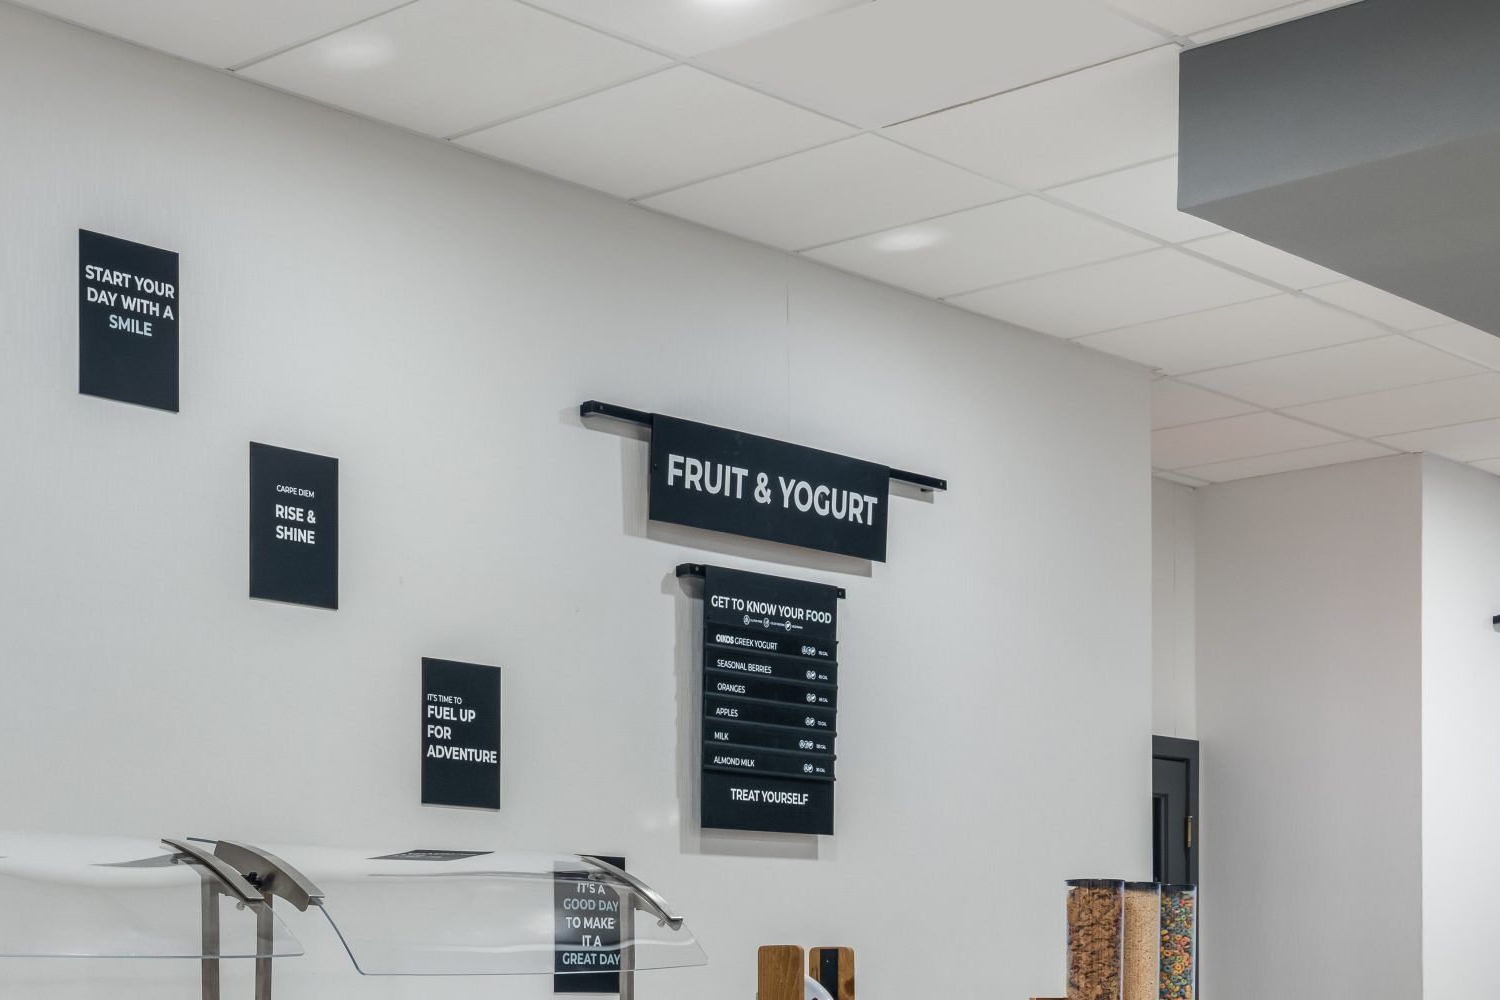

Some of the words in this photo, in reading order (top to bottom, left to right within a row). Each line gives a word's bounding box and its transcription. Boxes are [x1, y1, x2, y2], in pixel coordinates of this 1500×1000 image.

[85, 264, 131, 288] START
[134, 276, 175, 299] YOUR
[87, 287, 118, 306] DAY
[121, 295, 159, 316] WITH
[163, 305, 174, 320] A
[109, 315, 153, 337] SMILE
[277, 485, 297, 495] CARPE
[299, 488, 314, 498] DIEM
[668, 453, 748, 499] FRUIT
[754, 472, 772, 505] &
[779, 476, 878, 526] YOGURT
[276, 504, 304, 522] RISE
[307, 510, 316, 524] &
[276, 525, 316, 544] SHINE
[711, 595, 730, 608] GET
[731, 598, 744, 610] TO
[747, 600, 776, 616] KNOW
[778, 605, 804, 620] YOUR
[806, 610, 832, 624] FOOD
[716, 634, 734, 644] OIKOS
[734, 637, 753, 647] GREEK
[754, 640, 778, 650] YOGURT
[717, 659, 746, 670] SEASONAL
[748, 663, 772, 674] BERRIES
[717, 682, 746, 693] ORANGES
[427, 694, 437, 702] IT'S
[438, 694, 452, 703] TIME
[453, 696, 462, 704] TO
[428, 705, 457, 720] FUEL
[460, 708, 476, 722] UP
[716, 708, 738, 717] APPLES
[428, 725, 451, 740] FOR
[714, 732, 729, 740] MILK
[427, 744, 497, 764] ADVENTURE
[714, 756, 740, 766] ALMOND
[740, 758, 755, 767] MILK
[730, 788, 760, 801] TREAT
[762, 791, 808, 805] YOURSELF
[577, 882, 596, 894] IT'S
[598, 884, 606, 895] A
[564, 899, 595, 911] GOOD
[598, 900, 619, 912] DAY
[566, 917, 581, 929] TO
[584, 918, 615, 930] MAKE
[582, 935, 591, 947] IT
[593, 936, 602, 947] A
[562, 953, 597, 965] GREAT
[599, 953, 620, 965] DAY
